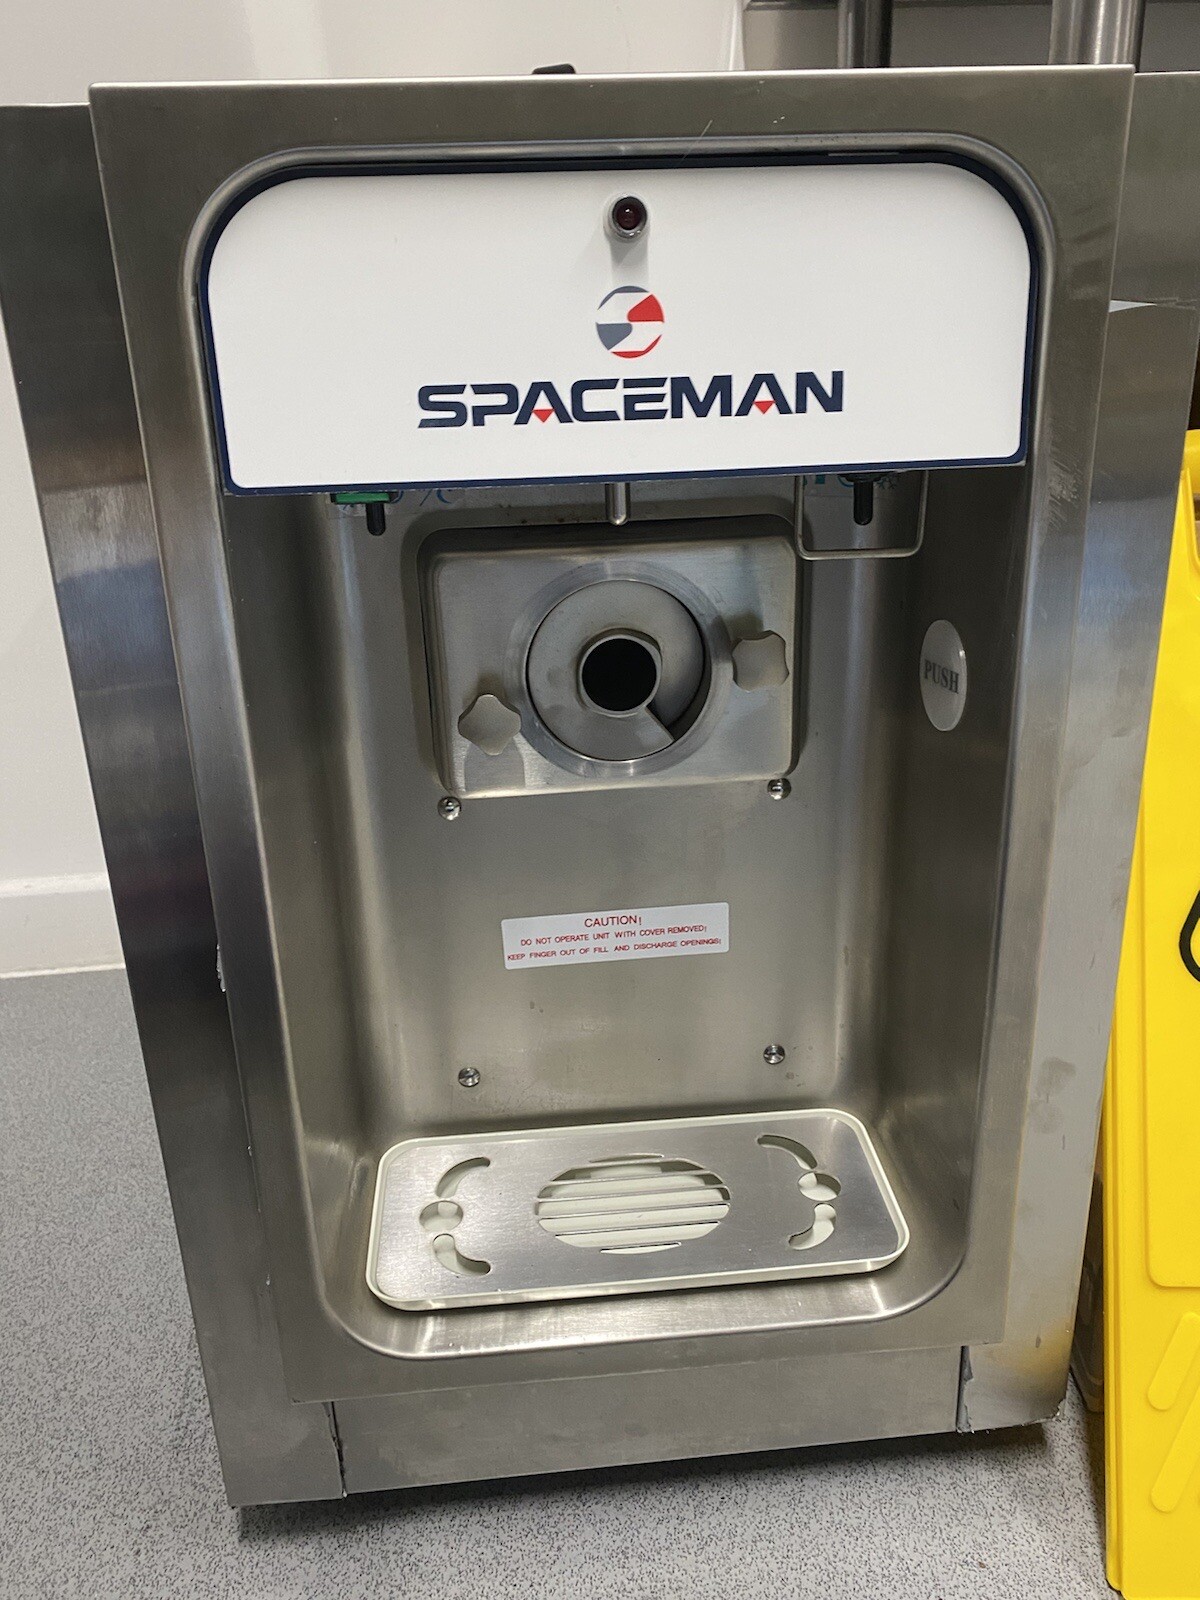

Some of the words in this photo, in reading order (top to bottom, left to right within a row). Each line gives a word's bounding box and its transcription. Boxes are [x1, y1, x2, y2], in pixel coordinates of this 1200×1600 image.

[417, 370, 844, 428] SPACEMAN
[924, 660, 960, 694] PUSH
[536, 937, 552, 945] NOT
[555, 934, 589, 943] OPERATE
[593, 932, 610, 940] UNIT
[615, 930, 636, 938] WITH
[640, 928, 665, 936] COVER
[507, 953, 526, 961] KEEP
[530, 950, 557, 958] FINGER
[560, 948, 576, 956] OUT
[614, 944, 630, 952] AND
[634, 940, 677, 950] DISCHARGE
